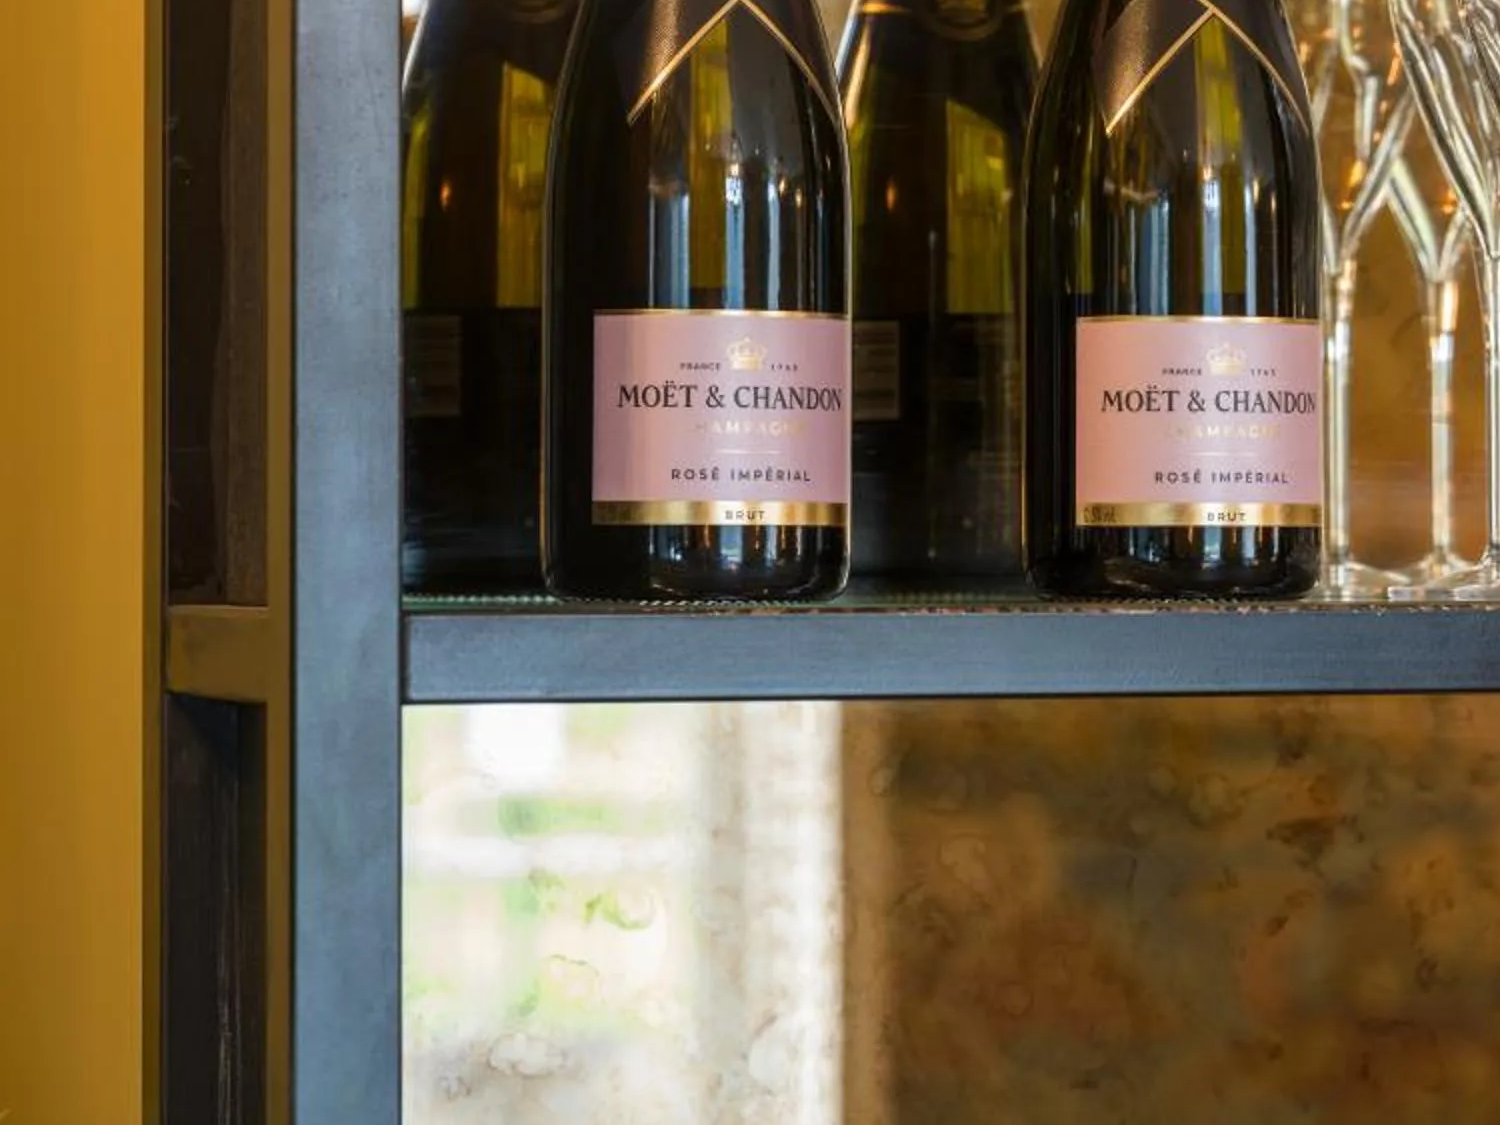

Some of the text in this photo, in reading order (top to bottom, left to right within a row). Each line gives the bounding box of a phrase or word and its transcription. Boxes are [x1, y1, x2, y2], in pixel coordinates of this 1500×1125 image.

[680, 362, 721, 372] FRANCE
[617, 380, 842, 412] MOËT & CHANDON
[1101, 384, 1316, 415] MOËT & CHANDON
[671, 467, 812, 482] ROSÉ IMPÉRIAL
[1154, 469, 1289, 485] ROSÉ IMPÉRIAL
[725, 510, 766, 521] BRUT
[1206, 512, 1246, 522] BRUT
